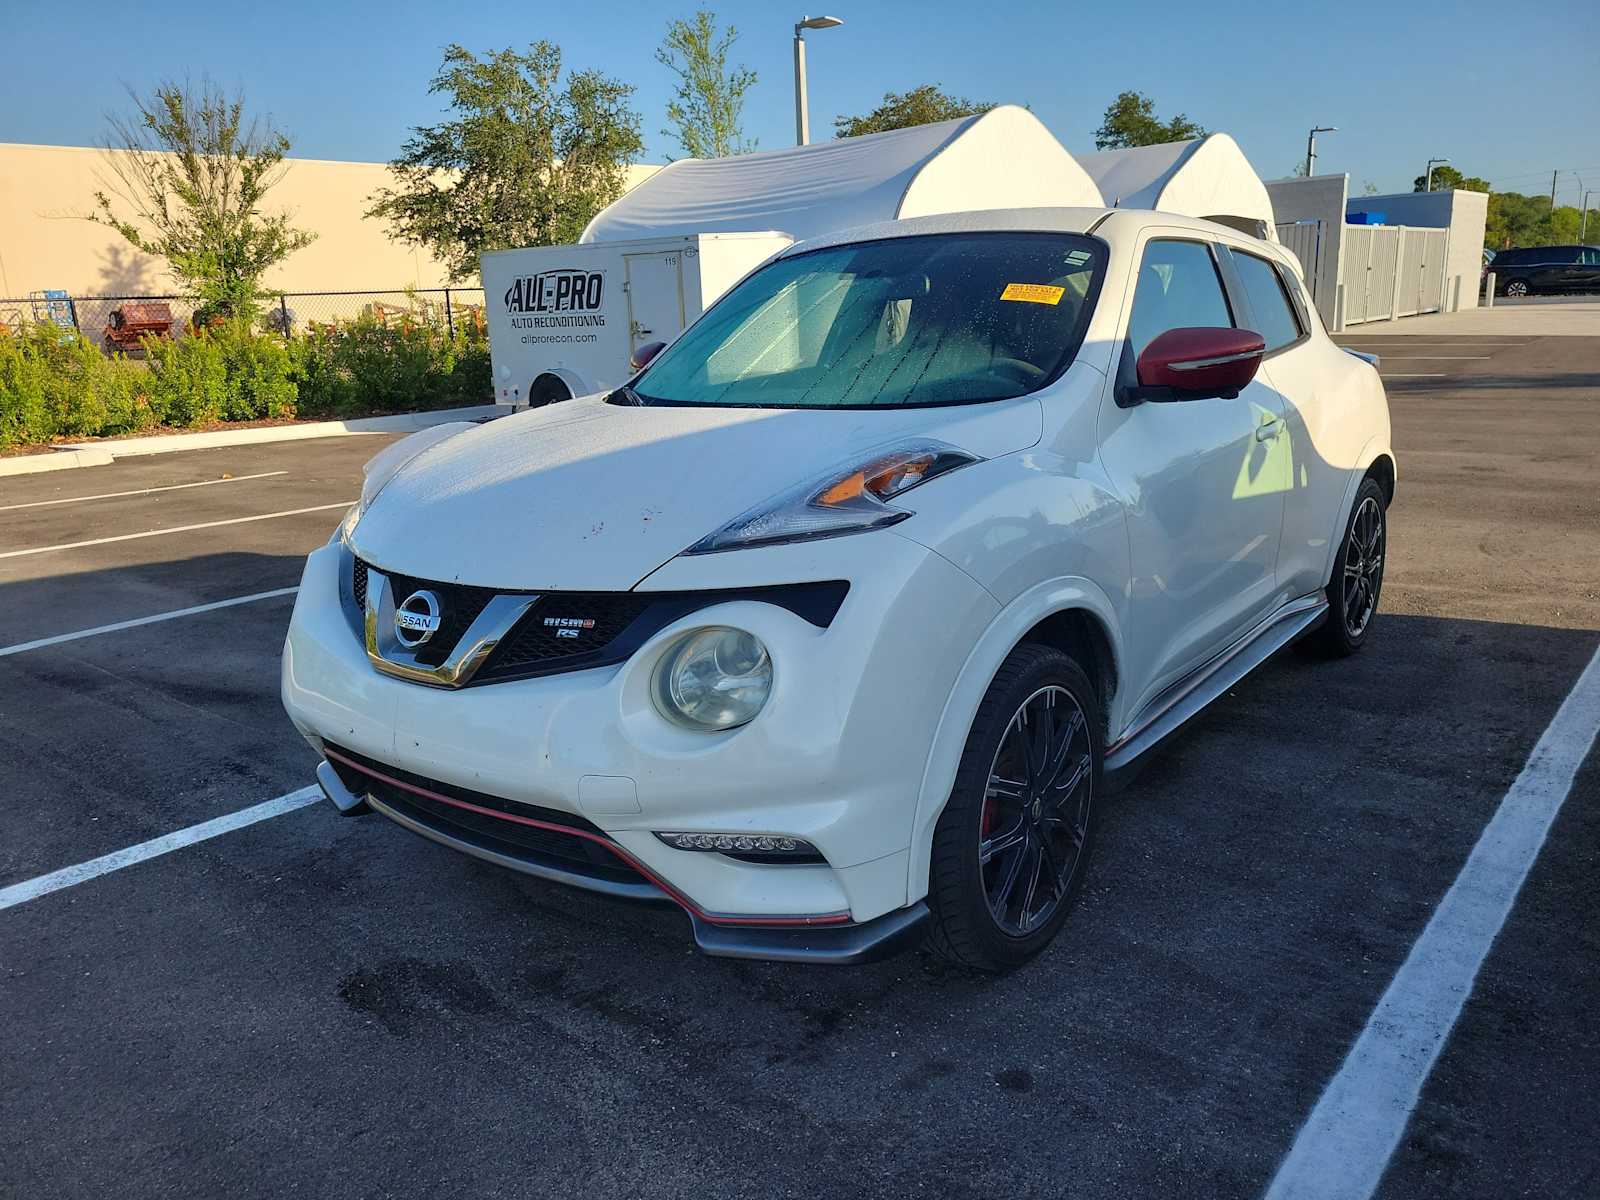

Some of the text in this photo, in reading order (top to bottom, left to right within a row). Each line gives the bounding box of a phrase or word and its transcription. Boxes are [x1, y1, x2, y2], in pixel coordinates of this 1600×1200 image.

[509, 273, 603, 313] ALL-PRO
[511, 315, 605, 329] AUTO RECONDITIONING
[521, 334, 597, 345] allprorecon.com
[556, 628, 580, 639] RS
